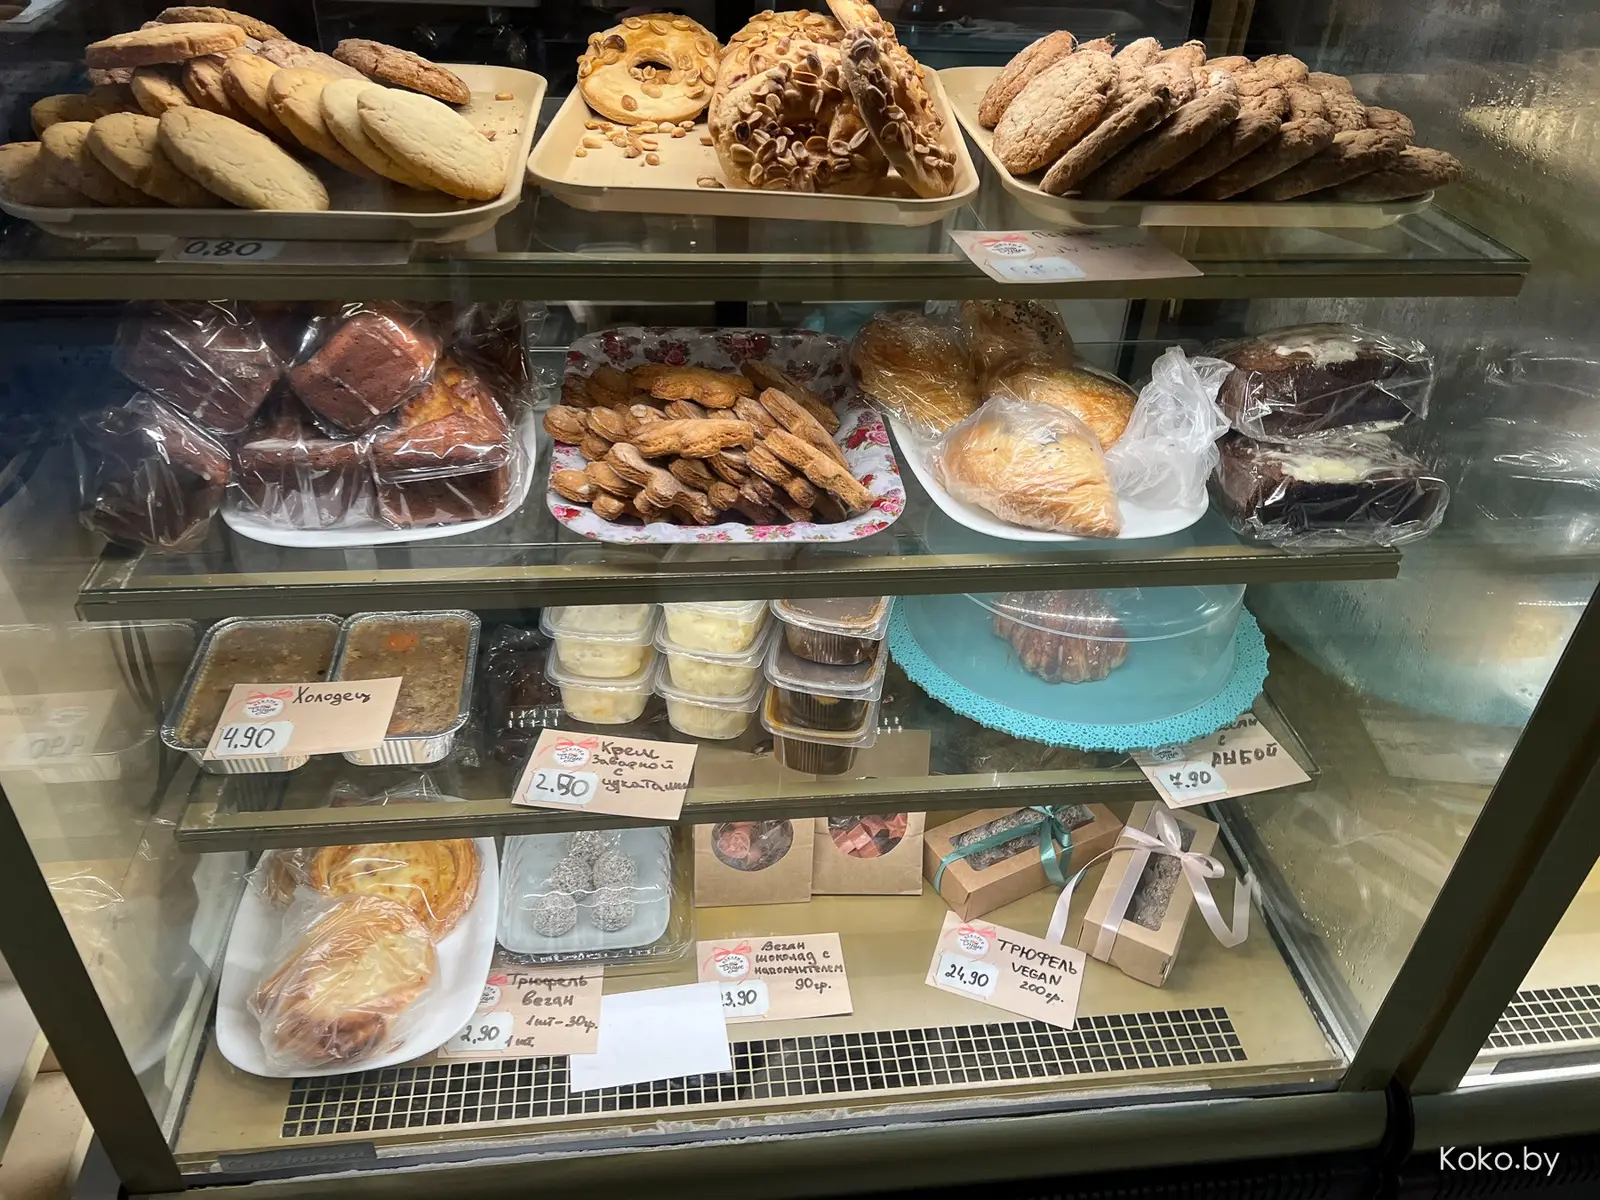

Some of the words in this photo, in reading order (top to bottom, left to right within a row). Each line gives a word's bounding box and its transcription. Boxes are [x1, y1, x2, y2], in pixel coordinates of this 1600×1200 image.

[184, 241, 262, 256] 0.80
[292, 686, 371, 706] Холодец
[223, 726, 275, 749] 4.90
[1211, 742, 1278, 768] РЫБОЙ
[1168, 770, 1212, 789] 7.90
[997, 938, 1078, 975] ТРЮФЕЛЬ
[754, 963, 844, 976] наполнителем
[944, 964, 990, 988] 24.90
[1011, 962, 1062, 986] VEGAN
